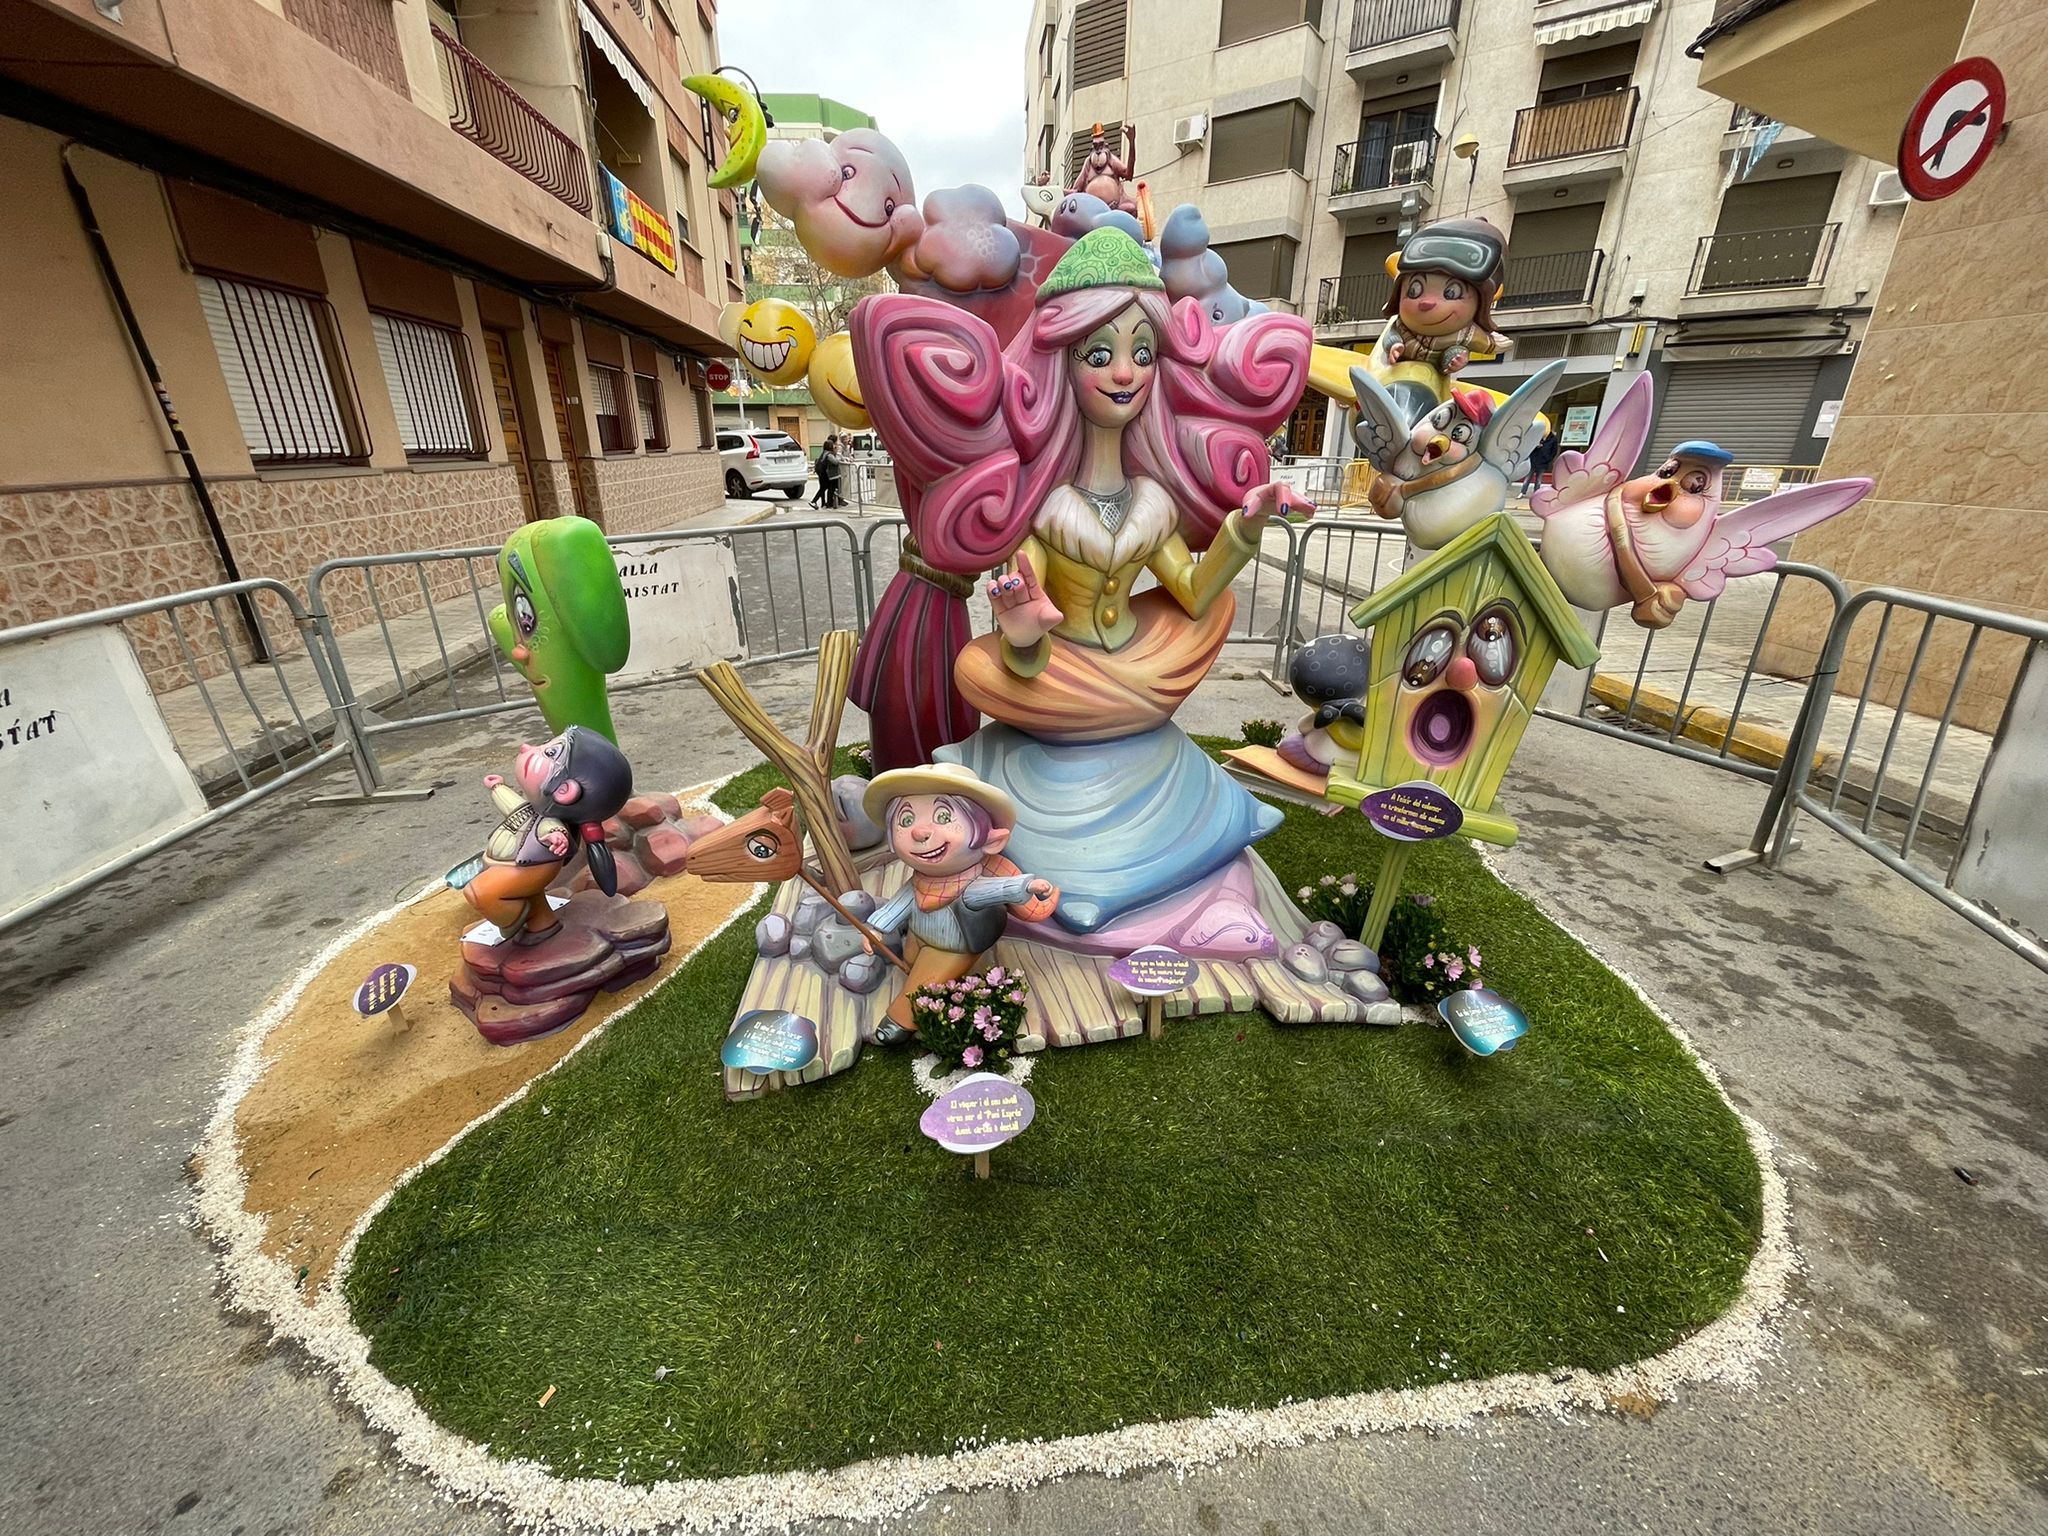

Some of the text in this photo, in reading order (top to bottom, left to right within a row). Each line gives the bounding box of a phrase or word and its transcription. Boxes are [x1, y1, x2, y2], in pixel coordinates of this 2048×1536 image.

[619, 563, 658, 577] ALLA
[624, 582, 679, 598] MISTAT
[1413, 799, 1421, 807] del
[950, 1100, 957, 1109] El
[984, 1097, 989, 1106] el
[977, 1112, 982, 1120] el
